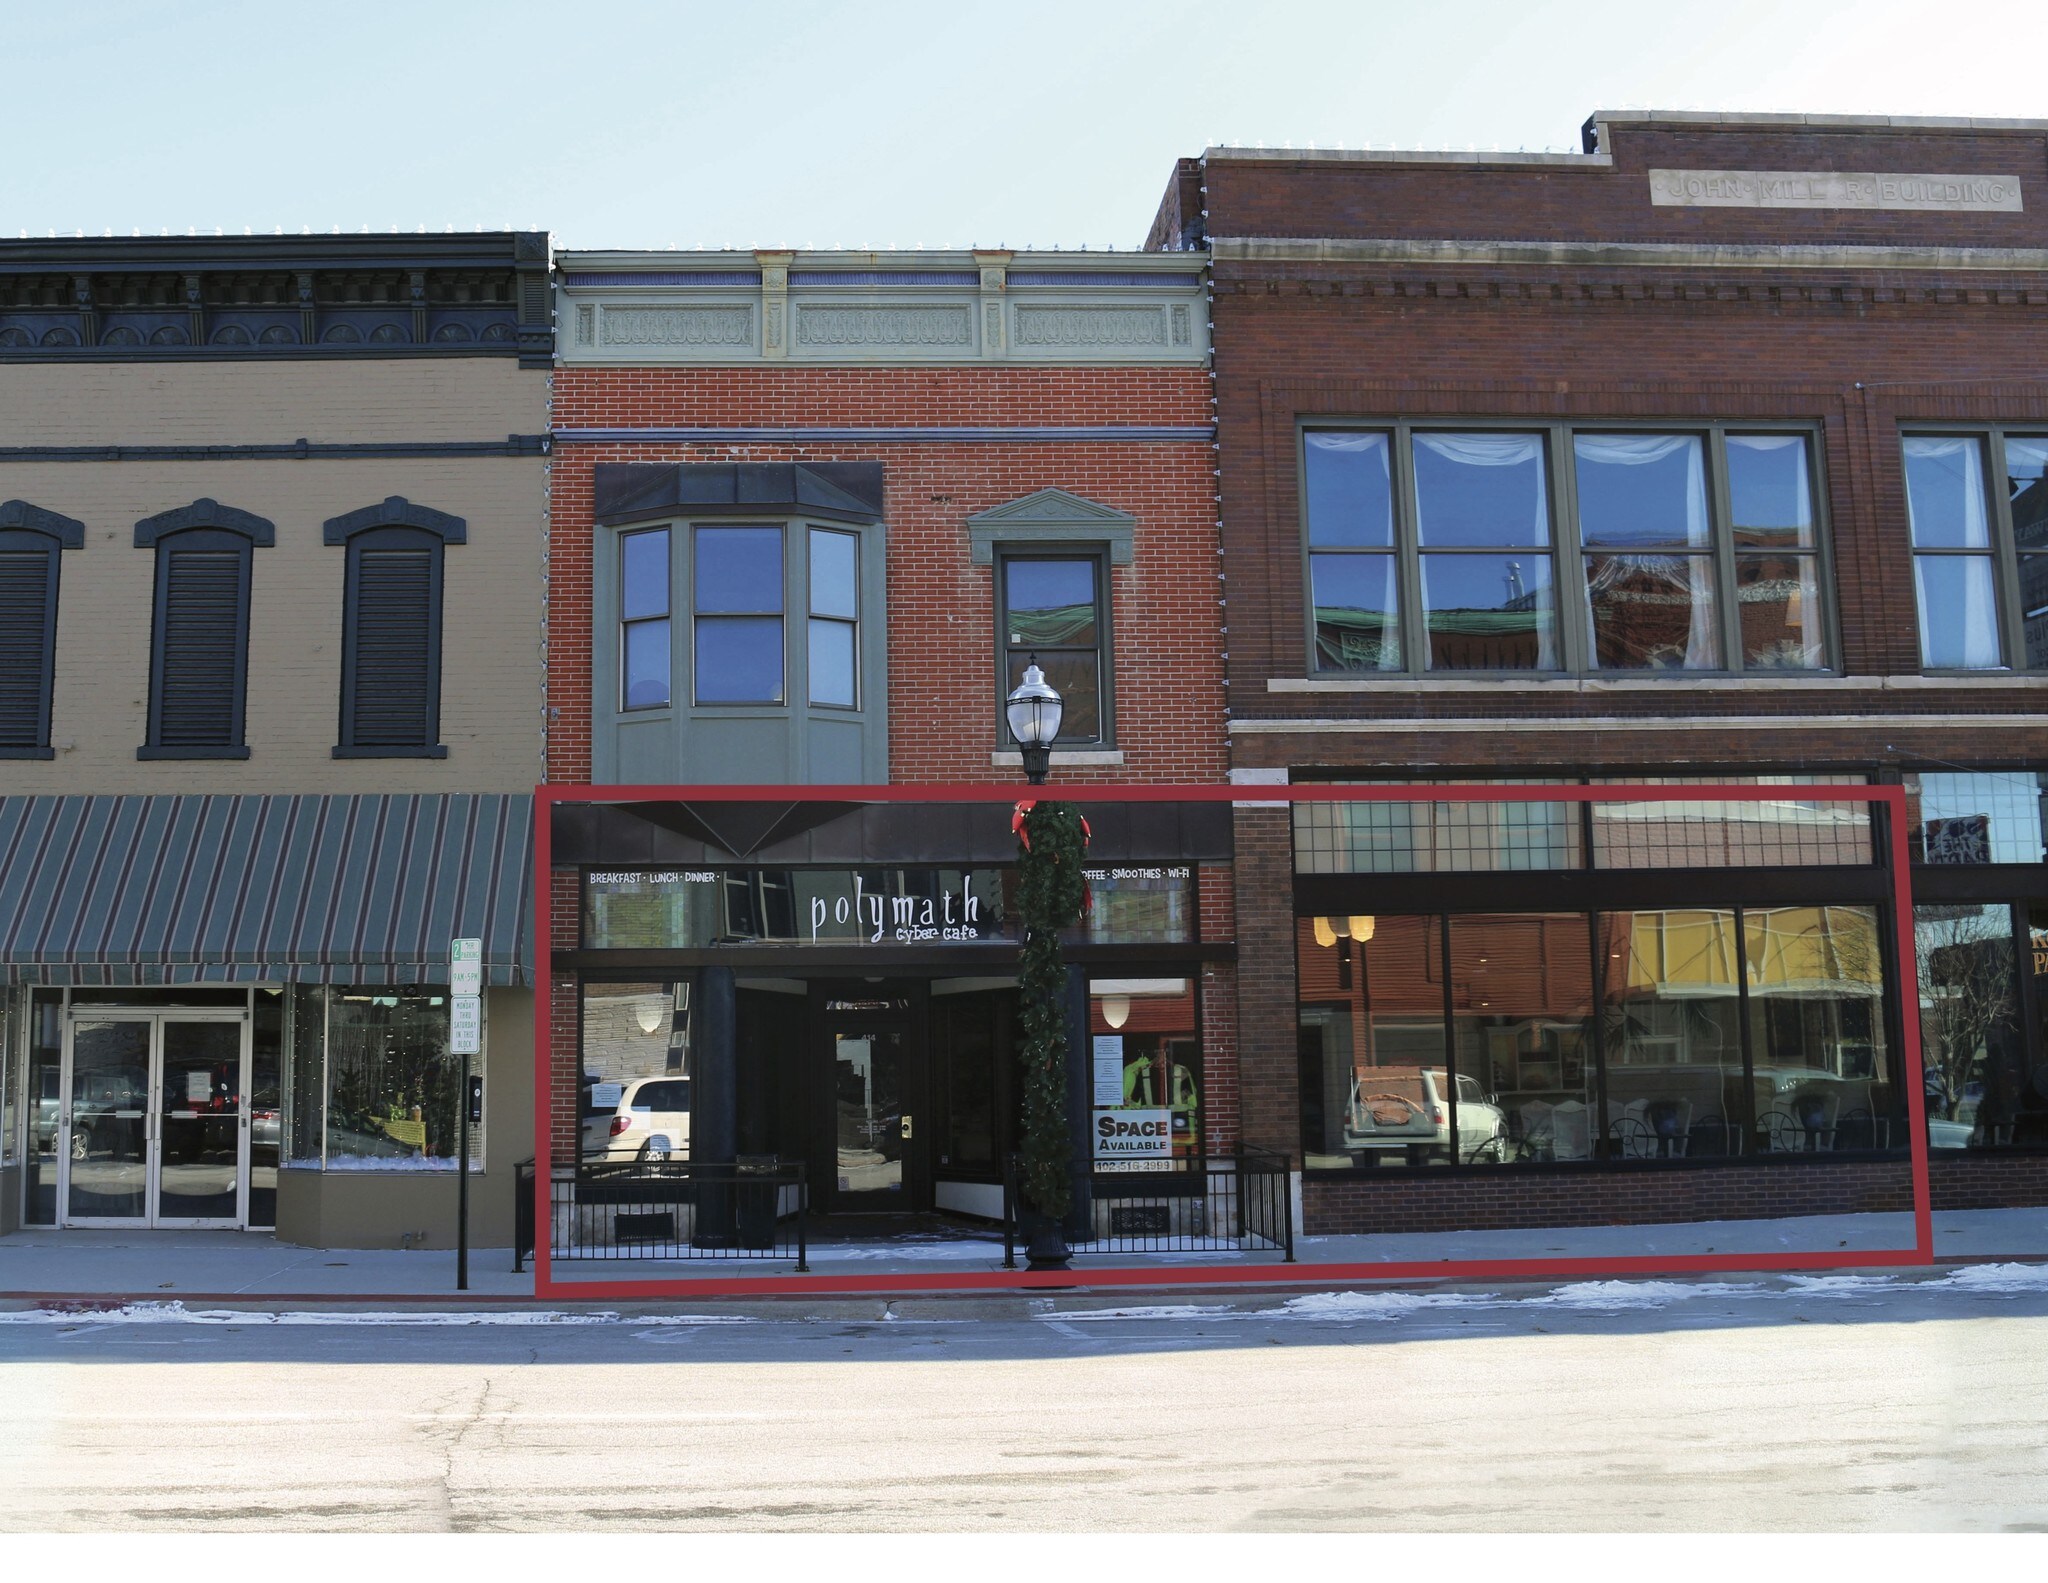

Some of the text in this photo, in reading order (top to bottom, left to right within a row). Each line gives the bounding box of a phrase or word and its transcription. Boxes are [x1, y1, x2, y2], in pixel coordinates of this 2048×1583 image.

[1668, 177, 2006, 203] JOHN MILLR BUILDING
[590, 871, 715, 884] BREAKFAST LUNCH DINNER
[1081, 868, 1190, 880] OFFEE SMOOTHIES WI-FI
[811, 875, 979, 944] polymath
[896, 924, 979, 945] cyber cafe
[454, 943, 460, 958] 2
[456, 1002, 475, 1010] MONDAY
[459, 1011, 472, 1019] THRU
[453, 1021, 477, 1029] SATURDAY
[456, 1030, 474, 1038] IN THIS
[457, 1040, 472, 1048] BLOCK
[1098, 1116, 1168, 1138] SPACE
[1098, 1139, 1167, 1151] AVAILABLE
